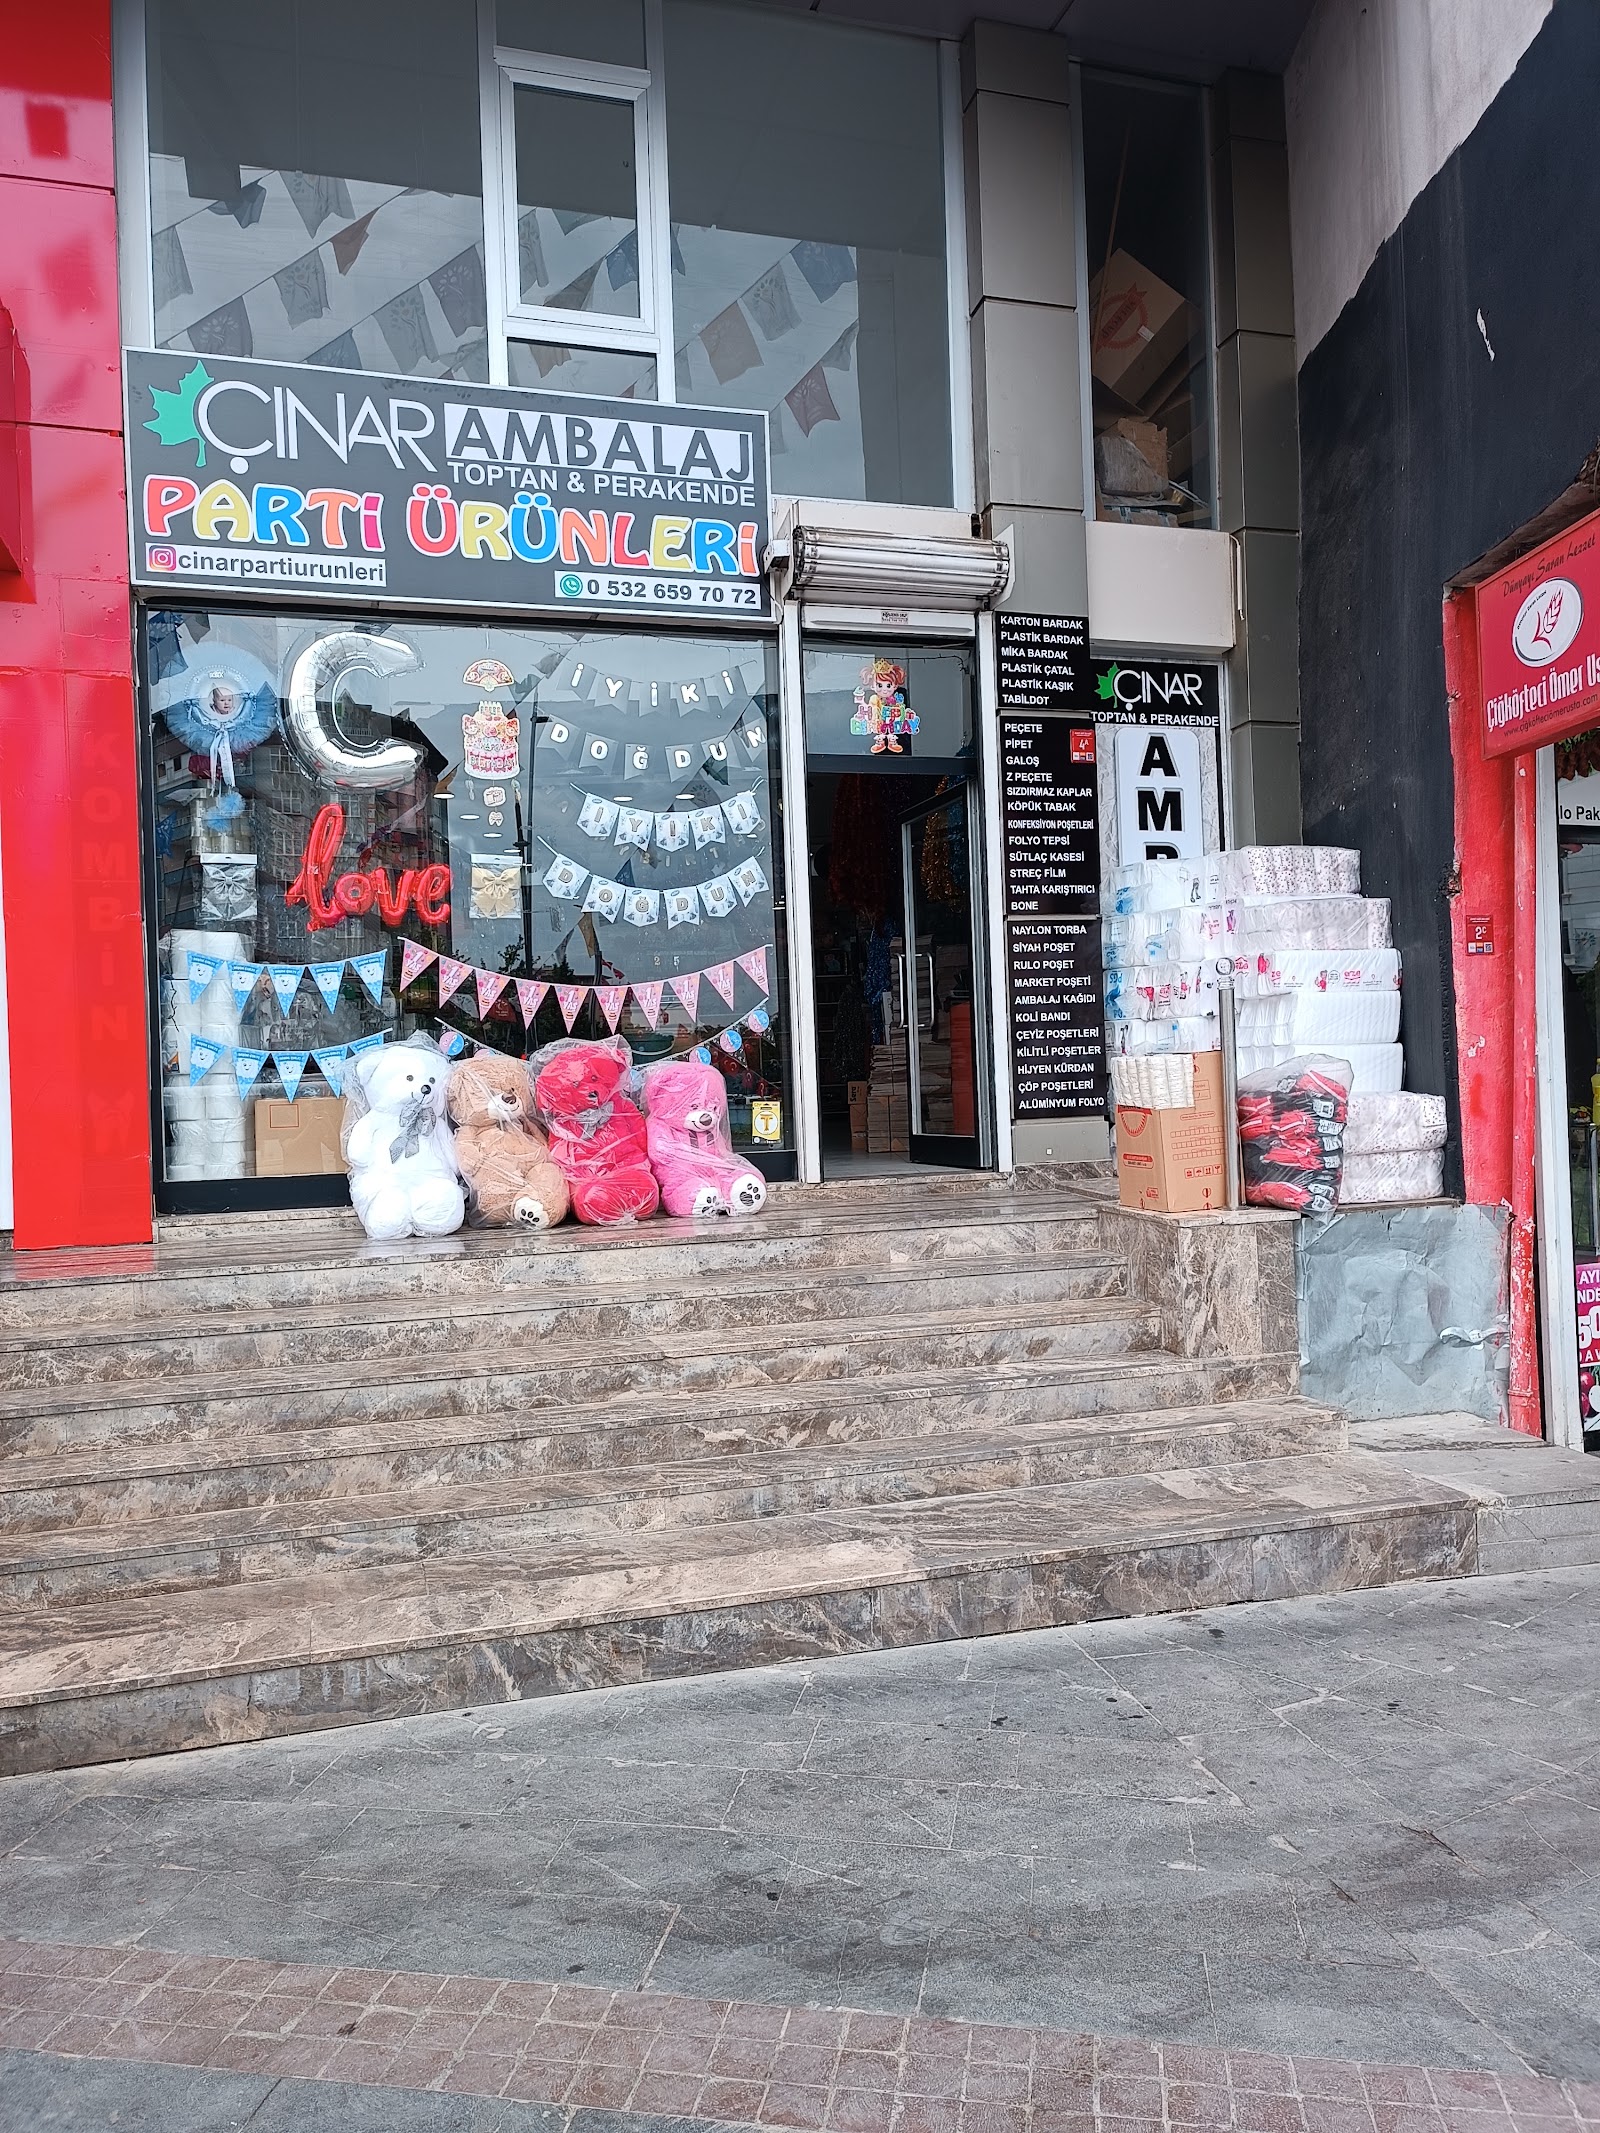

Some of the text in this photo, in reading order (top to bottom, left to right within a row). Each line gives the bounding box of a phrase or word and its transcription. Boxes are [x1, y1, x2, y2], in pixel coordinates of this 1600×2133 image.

[198, 380, 750, 482] ÇINAR AMBALAJ
[447, 461, 756, 507] TOPTAN & PERAKENDE
[178, 551, 384, 582] cinarpartiurunleri
[587, 579, 757, 604] 0 532 659 70 72
[1000, 616, 1083, 630] KARTON BARDAK
[1001, 631, 1084, 645] PLASTİK BARDAK
[1001, 645, 1068, 660] MİKA BARDAK
[1001, 663, 1075, 676] PLASTİK ÇATAL
[1002, 678, 1074, 692] PLASTİK KAŞIK
[1114, 669, 1204, 711] ÇINAR
[1002, 693, 1049, 705] TABİLDOT
[1487, 676, 1548, 733] Çiğköfteci
[1549, 667, 1583, 703] Ömer
[1090, 711, 1219, 726] TOPTAN & PERAKENDE
[1005, 723, 1042, 734] PEÇETE
[1005, 738, 1033, 749] PİPET
[1006, 756, 1039, 767] GALOŞ
[1006, 772, 1052, 783] Z PEÇETE
[1007, 787, 1092, 797] SIZDIRMAZ KAPLAR
[1007, 801, 1076, 812] KÖPÜK TABAK
[1008, 818, 1094, 831] KONFEKSİYON POŞETLERİ
[1009, 835, 1070, 845] FOLYO TEPSİ
[1009, 851, 1084, 863] SÜTLAÇ KASESİ
[285, 803, 454, 932] love
[1010, 867, 1066, 879] STREÇ FİLM
[1010, 885, 1095, 896] TAHTA KARIŞTIRICI
[1011, 901, 1038, 910] BONE
[1012, 925, 1087, 935] NAYLON TORBA
[1013, 942, 1075, 953] SİYAH POŞET
[1013, 960, 1075, 971] RULO POŞET
[1014, 975, 1091, 988] MARKET POŞETİ
[1014, 993, 1096, 1005] AMBALAJ KAĞIDI
[1015, 1011, 1071, 1022] KOLİ BANDI
[1016, 1027, 1099, 1041] ÇEYİZ POŞETLERİ
[1017, 1045, 1101, 1057] KİLİTLİ POŞETLER
[1017, 1062, 1094, 1074] HİJYEN KÜRDAN
[1018, 1078, 1093, 1094] ÇÖP POŞETLERİ
[1019, 1097, 1104, 1109] ALÜMİNYUM FOLYO
